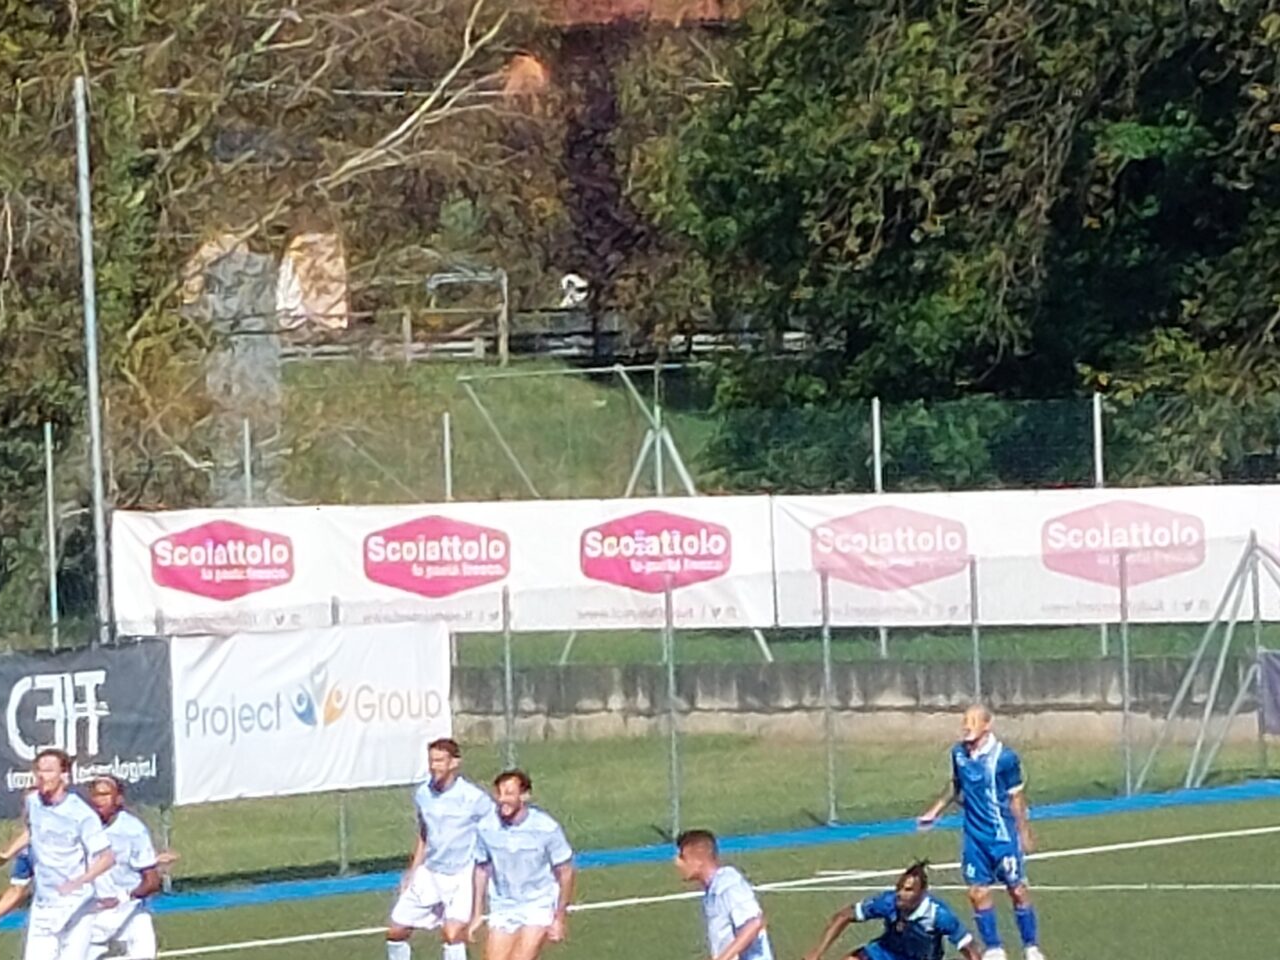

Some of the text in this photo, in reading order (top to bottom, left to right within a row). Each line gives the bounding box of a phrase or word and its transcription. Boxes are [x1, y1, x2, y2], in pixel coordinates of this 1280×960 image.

[367, 533, 506, 562] Scoiattolo
[583, 528, 726, 557] Scoiattolo
[815, 525, 963, 553] Scoiattolo
[1047, 519, 1200, 549] Scoiattolo
[154, 538, 289, 566] Scoiattolo
[184, 683, 443, 746] Project Group
